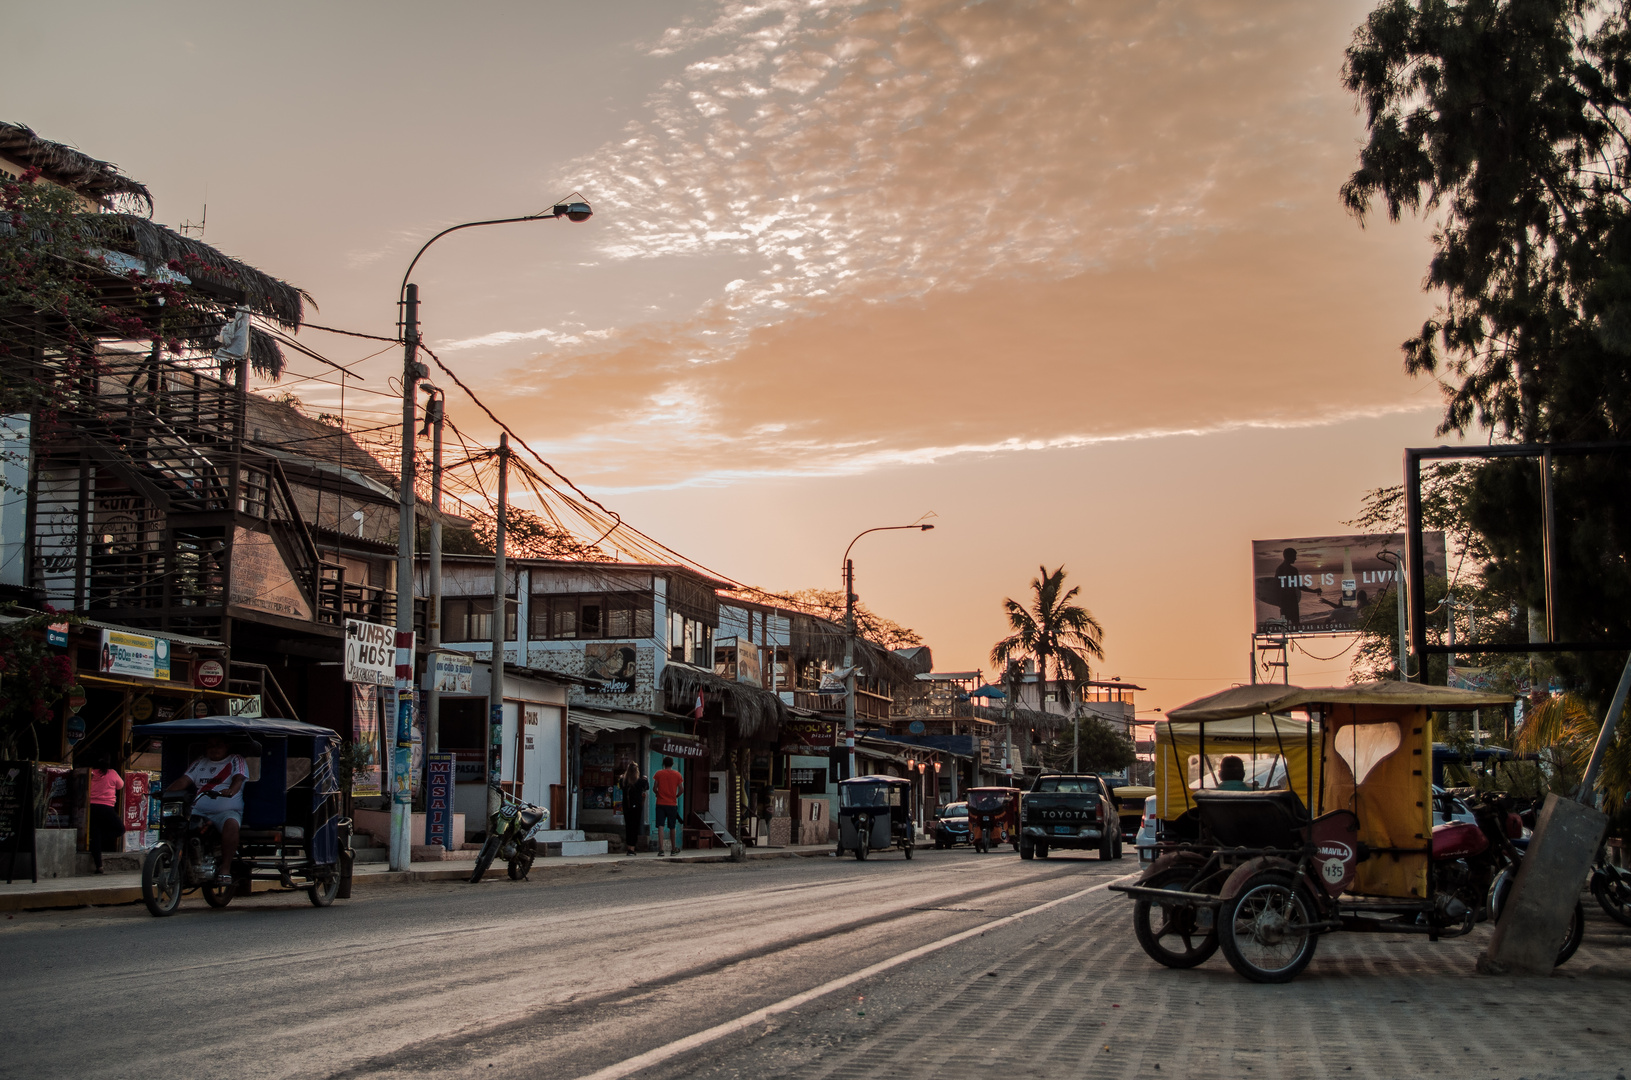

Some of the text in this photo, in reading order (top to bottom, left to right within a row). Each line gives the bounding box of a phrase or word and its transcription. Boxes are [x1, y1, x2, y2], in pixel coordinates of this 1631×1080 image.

[1278, 571, 1403, 588] THIS IS LIVI
[347, 621, 398, 649] RUNASI
[358, 644, 396, 667] HOST
[429, 762, 450, 845] MASAJES
[500, 805, 517, 817] 461
[1042, 811, 1088, 819] TOYOTA
[1321, 847, 1348, 856] MAVILA
[1325, 866, 1343, 877] 435
